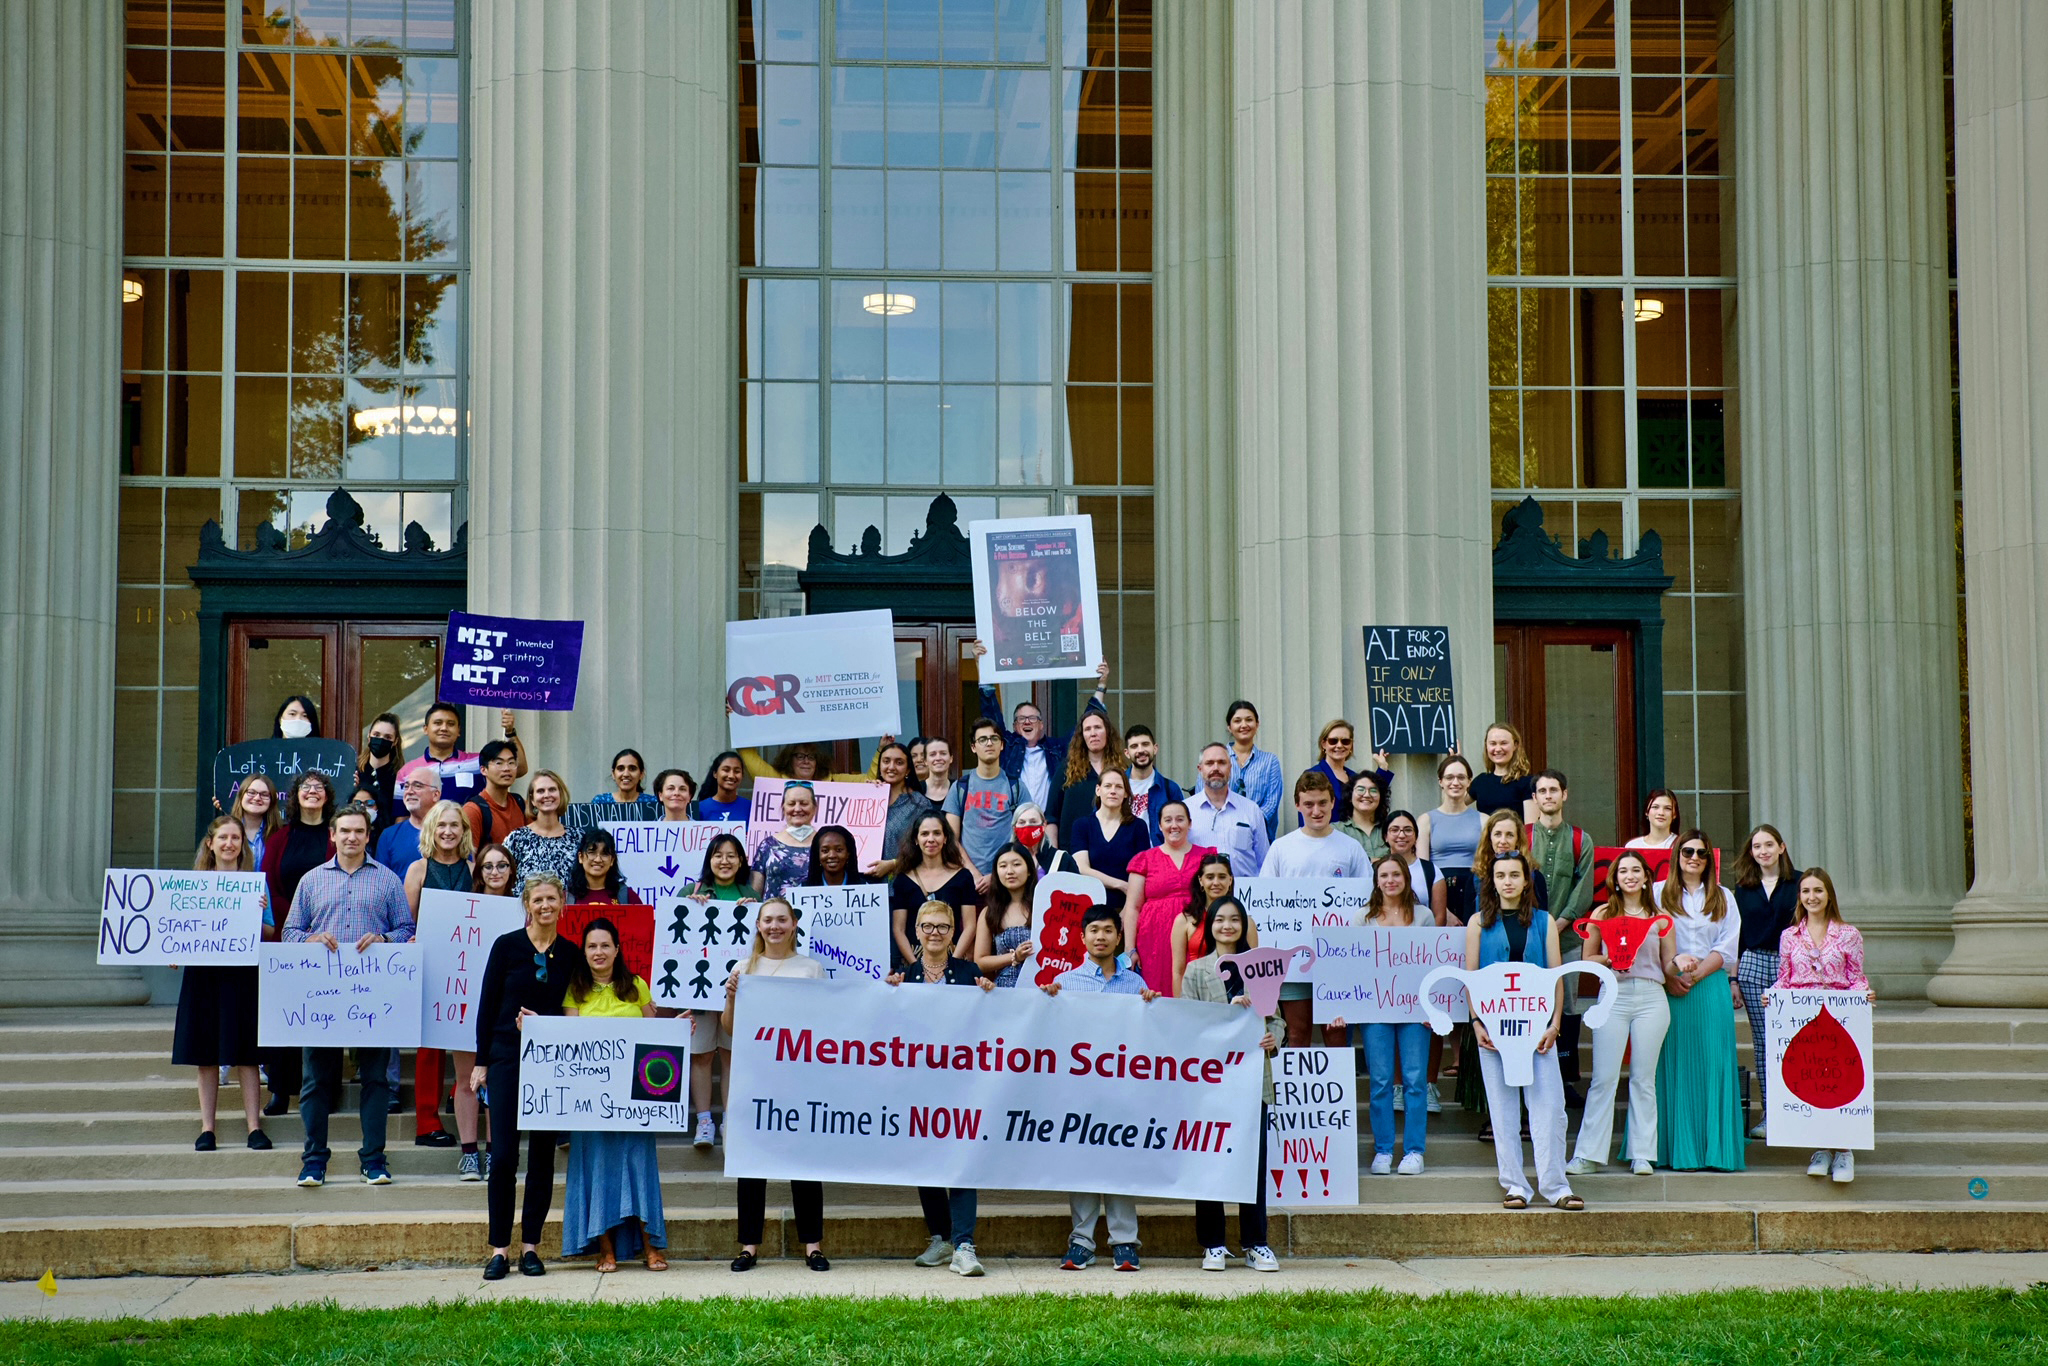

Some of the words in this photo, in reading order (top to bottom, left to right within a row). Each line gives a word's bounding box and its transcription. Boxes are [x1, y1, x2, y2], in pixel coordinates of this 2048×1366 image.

[1016, 606, 1056, 616] BELOW
[1028, 620, 1047, 628] THE
[457, 626, 508, 647] MIT
[515, 638, 554, 649] invented
[1024, 632, 1051, 642] BELT
[1366, 628, 1400, 660] AI
[1407, 629, 1431, 644] FOR
[472, 648, 494, 661] 3D
[503, 654, 544, 667] printing
[452, 663, 506, 685] MIT
[511, 674, 530, 684] can
[804, 676, 814, 684] the
[816, 674, 832, 684] MIT
[834, 672, 870, 682] CENTER
[871, 672, 880, 681] for
[1370, 666, 1390, 682] IF
[1400, 666, 1436, 680] ONLY
[468, 686, 551, 703] endometriosis!
[802, 686, 884, 699] GYNEPATHOLOGY
[1370, 686, 1413, 703] THERE
[1417, 687, 1451, 702] WERE
[820, 702, 869, 712] RESEARCH
[1372, 704, 1454, 748] DATA!
[228, 752, 266, 774] Let's
[276, 752, 302, 775] talk
[754, 791, 848, 824] HETHY
[964, 790, 1008, 812] MIT
[564, 803, 643, 828] ENSTRUATION
[104, 874, 154, 912] NO
[159, 875, 208, 892] WOMEN'S
[217, 876, 262, 893] HEALTH
[170, 893, 242, 911] RESEARCH
[842, 888, 880, 908] TALK
[1239, 886, 1317, 911] Menstruation
[1322, 886, 1367, 908] Scienc
[464, 898, 480, 918] I
[812, 911, 866, 928] ABOUT
[1266, 914, 1290, 932] time
[100, 914, 150, 954] NO
[161, 934, 255, 954] COMPANIES!
[450, 925, 482, 946] AM
[1620, 936, 1627, 946] 1
[700, 947, 708, 958] 1
[1316, 938, 1348, 958] Does
[1350, 942, 1370, 958] the
[1374, 930, 1432, 968] Health
[1436, 932, 1466, 968] Gap
[268, 958, 294, 974] Does
[300, 958, 321, 970] the
[327, 949, 381, 978] Health
[387, 952, 416, 981] Gap
[457, 950, 467, 972] 1
[1042, 956, 1072, 972] pain
[1244, 958, 1284, 980] OUCH
[350, 984, 372, 994] the
[446, 976, 468, 996] IN
[1504, 973, 1520, 992] I
[1354, 985, 1373, 1000] the
[1374, 974, 1420, 1014] Wage
[1769, 992, 1784, 1014] My
[1791, 991, 1824, 1006] bone
[1828, 994, 1869, 1006] marrow
[432, 1002, 468, 1024] 10!
[1480, 996, 1548, 1014] MATTER
[283, 1003, 336, 1030] Wage
[1772, 1019, 1782, 1029] is
[522, 1038, 626, 1064] ADENOMYOSIS
[1778, 1032, 1838, 1050] replacing
[1283, 1050, 1329, 1076] END
[1776, 1053, 1795, 1065] the
[1800, 1068, 1842, 1080] BLOOD
[1272, 1081, 1344, 1106] ERIOD
[1792, 1082, 1799, 1092] I
[556, 1086, 570, 1116] I
[574, 1099, 593, 1114] AM
[1783, 1102, 1812, 1118] every
[1840, 1104, 1872, 1116] month
[752, 1098, 800, 1132] The
[806, 1101, 872, 1135] Time
[880, 1106, 900, 1136] is
[909, 1106, 988, 1140] NOW.
[1005, 1110, 1054, 1142] The
[1059, 1112, 1138, 1148] Place
[1143, 1118, 1168, 1150] is
[1172, 1120, 1232, 1154] MIT.
[1268, 1110, 1351, 1132] RIVILEGE
[1283, 1136, 1329, 1164] NOW
